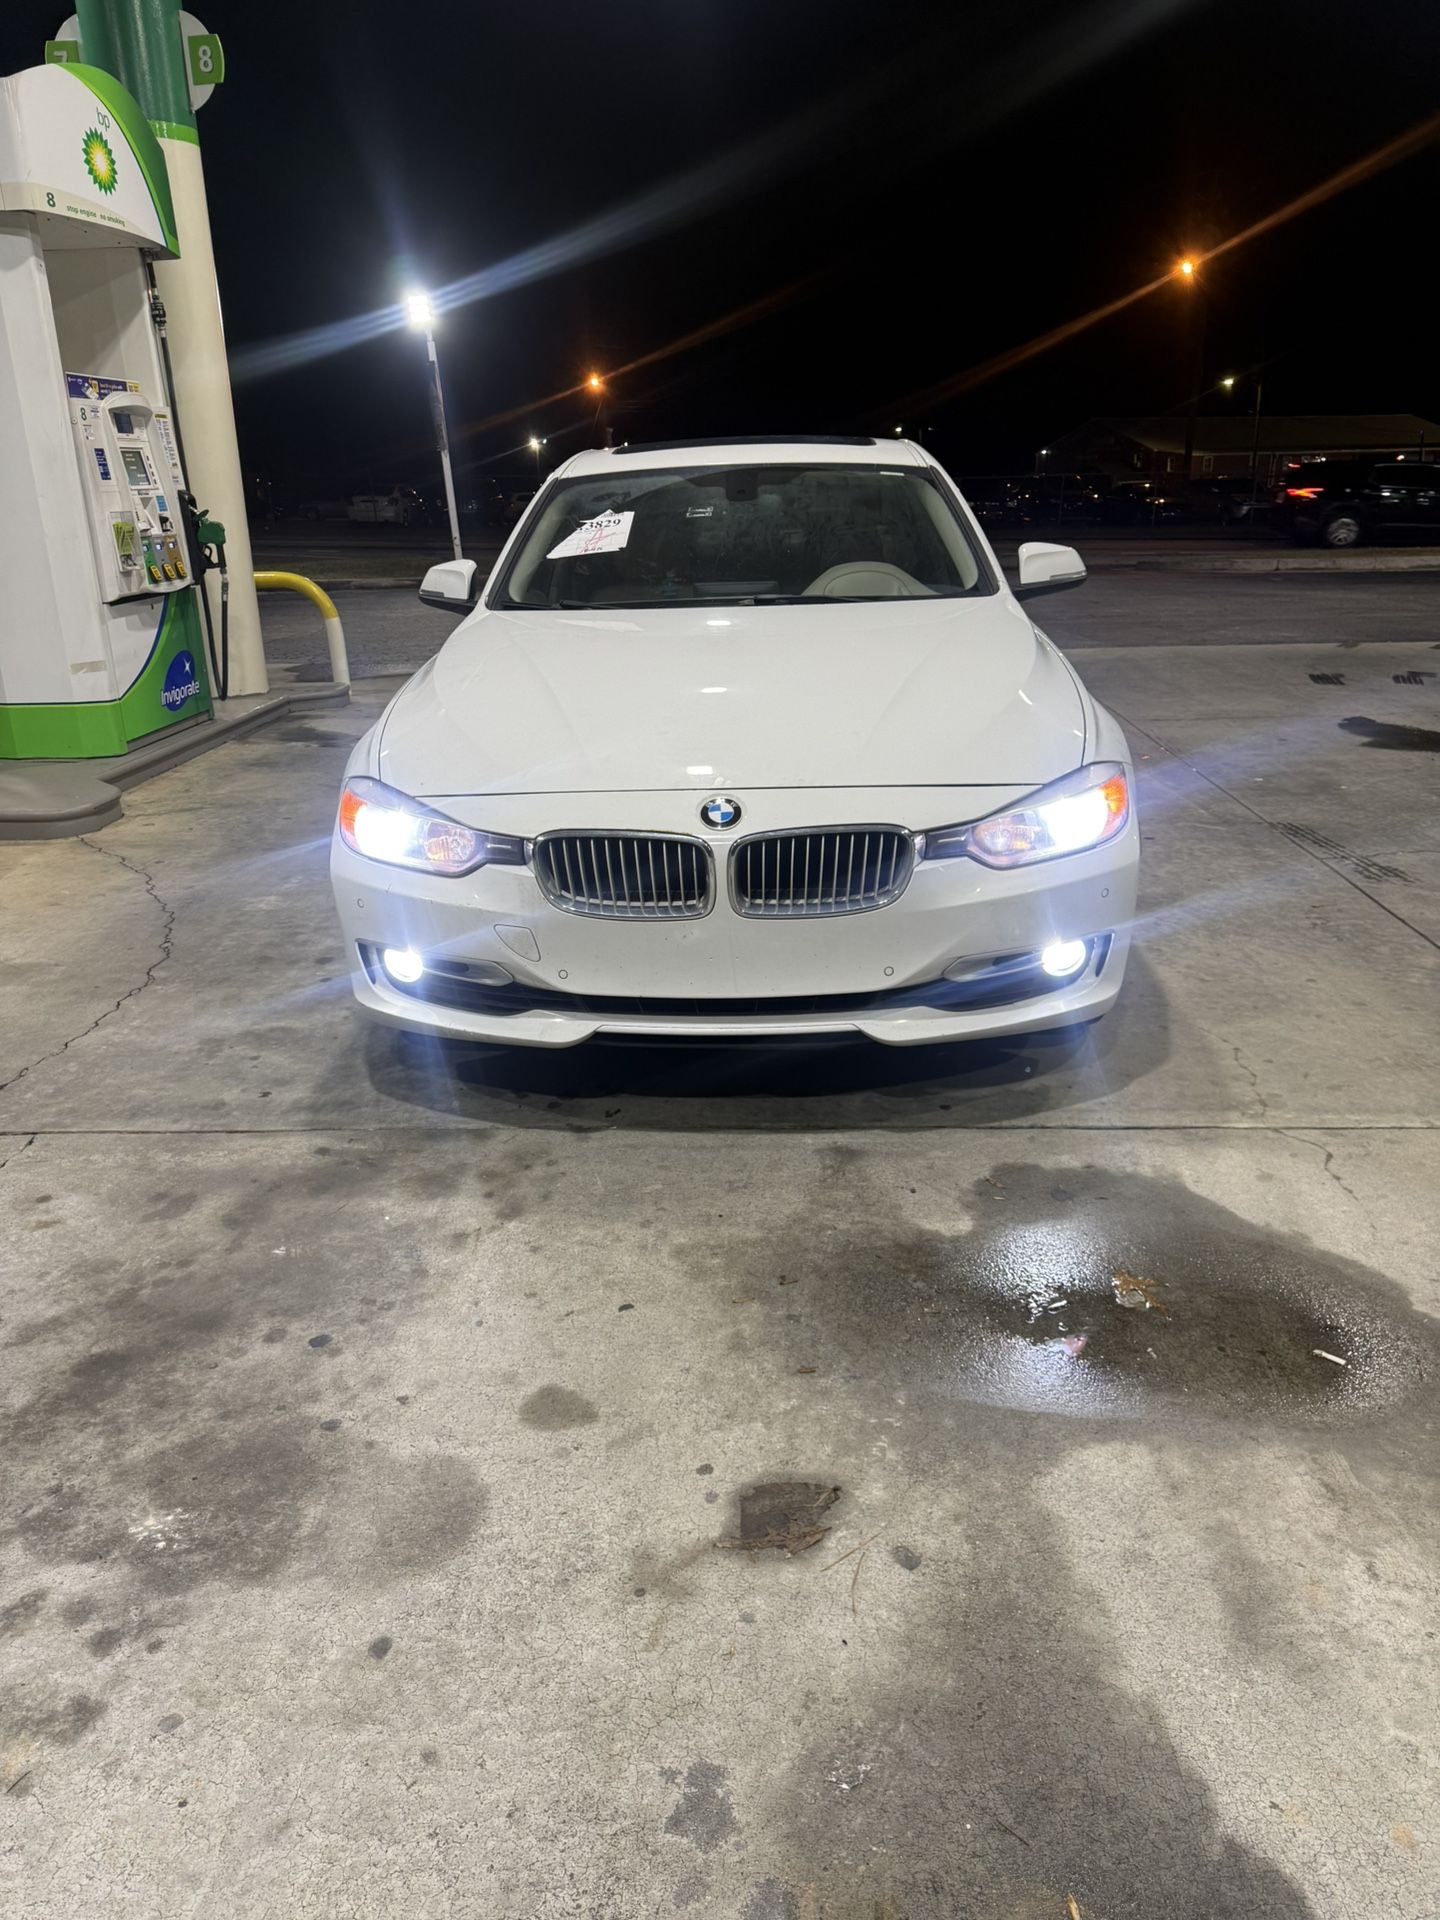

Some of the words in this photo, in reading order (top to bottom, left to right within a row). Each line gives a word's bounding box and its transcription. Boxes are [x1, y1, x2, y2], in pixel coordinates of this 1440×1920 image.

[53, 50, 68, 63] 7
[198, 45, 213, 73] 8
[96, 107, 111, 131] bp
[46, 191, 56, 208] 8
[80, 407, 87, 421] 8
[578, 518, 621, 531] 3829
